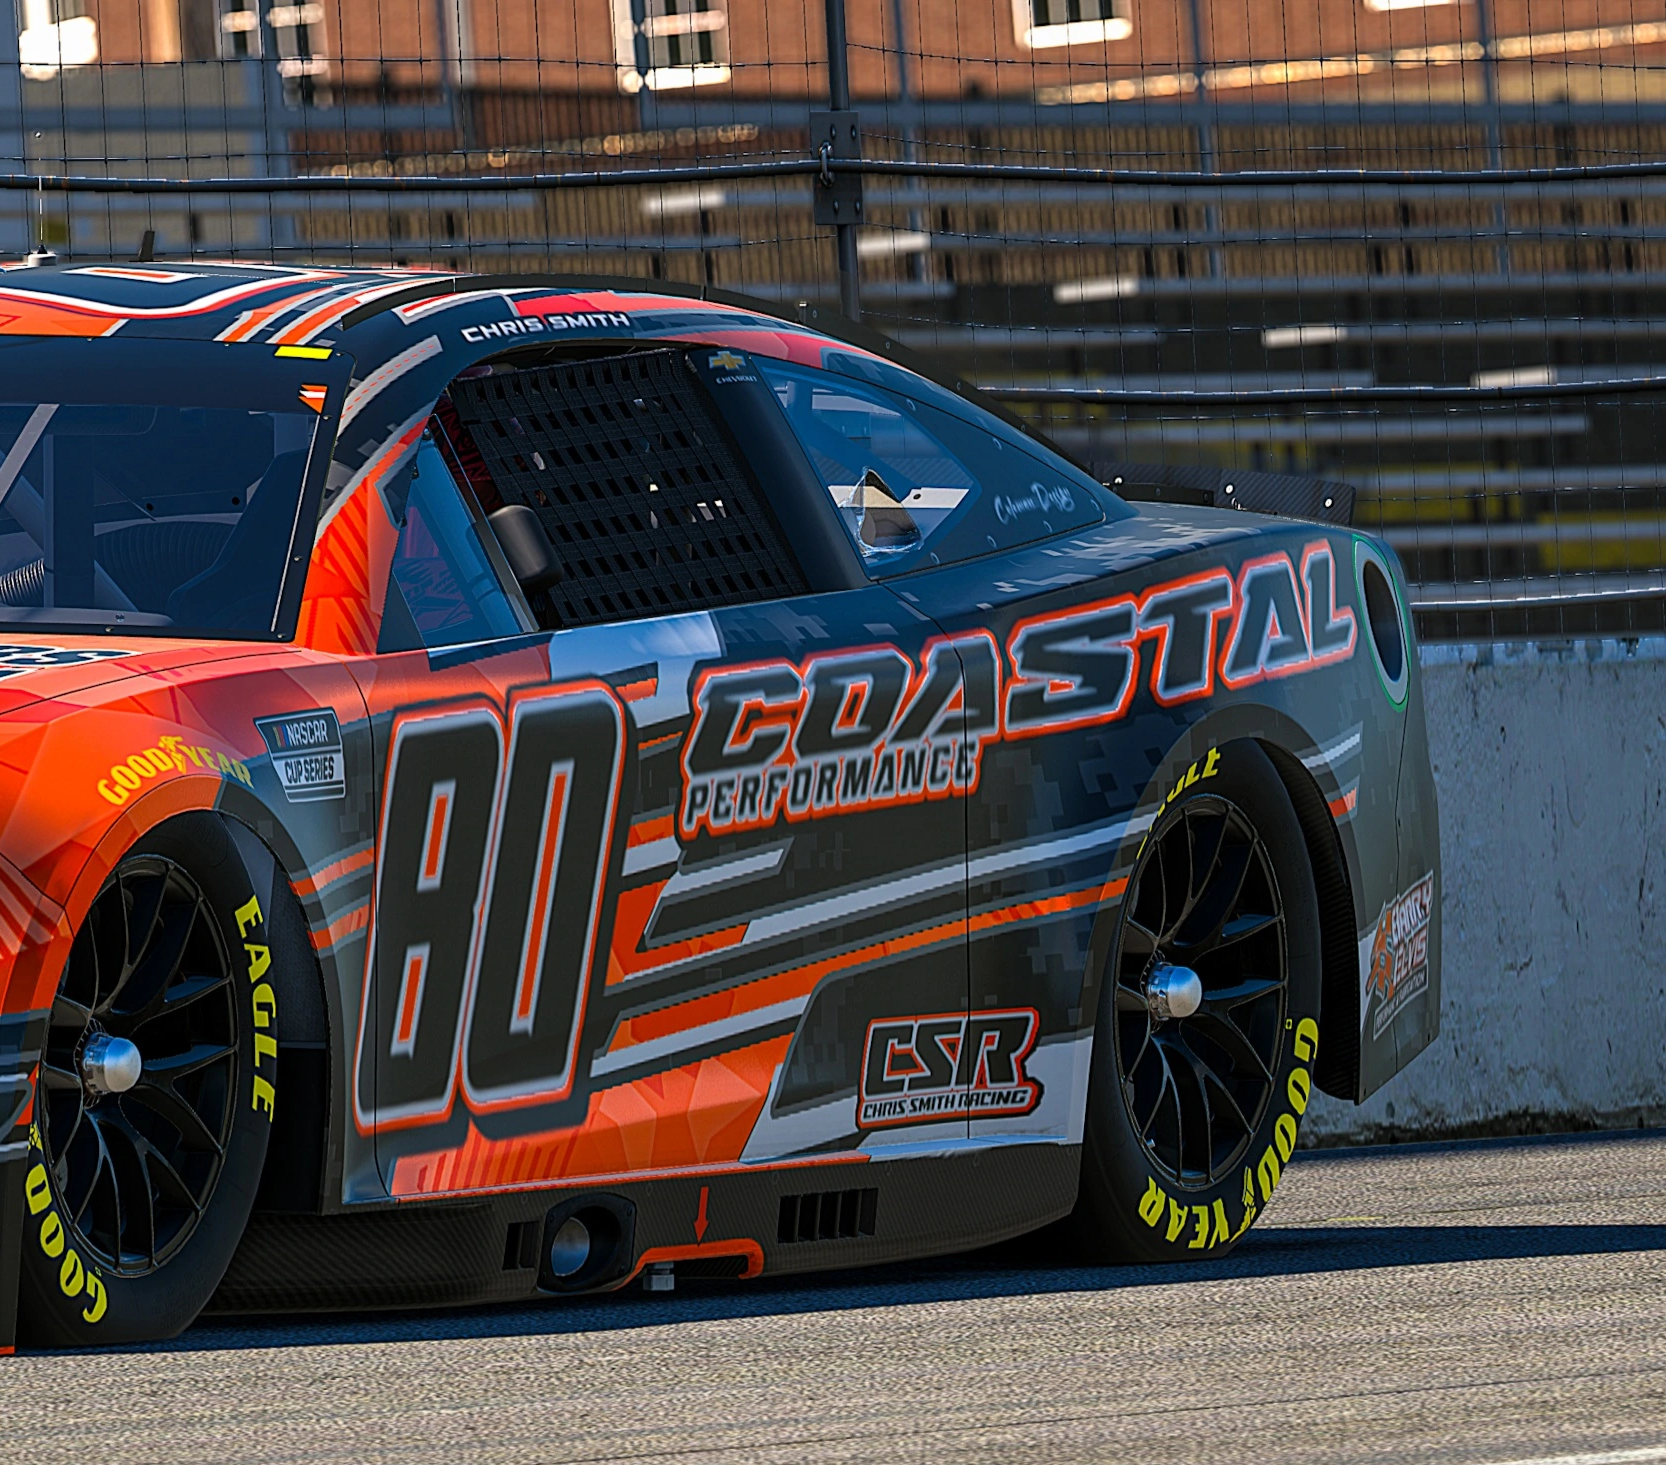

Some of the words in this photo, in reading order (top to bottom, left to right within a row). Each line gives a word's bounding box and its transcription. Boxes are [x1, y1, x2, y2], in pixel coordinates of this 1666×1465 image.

[461, 317, 545, 343] CHRIS
[548, 312, 632, 331] SMITH
[682, 538, 1361, 780] COASTAL
[97, 736, 256, 806] GOODYEAR
[284, 759, 303, 784] CUP
[304, 756, 335, 782] SERIES
[285, 720, 329, 746] NASCAR
[683, 741, 978, 832] PERFORMANCE
[353, 680, 626, 1137] 80
[234, 894, 277, 1122] EAGLE
[864, 1012, 1034, 1097] CSR
[863, 1099, 906, 1120] CHRIS
[909, 1093, 958, 1113] SMITH
[959, 1089, 1029, 1108] RACING
[1138, 1017, 1319, 1249] GOODYEAR
